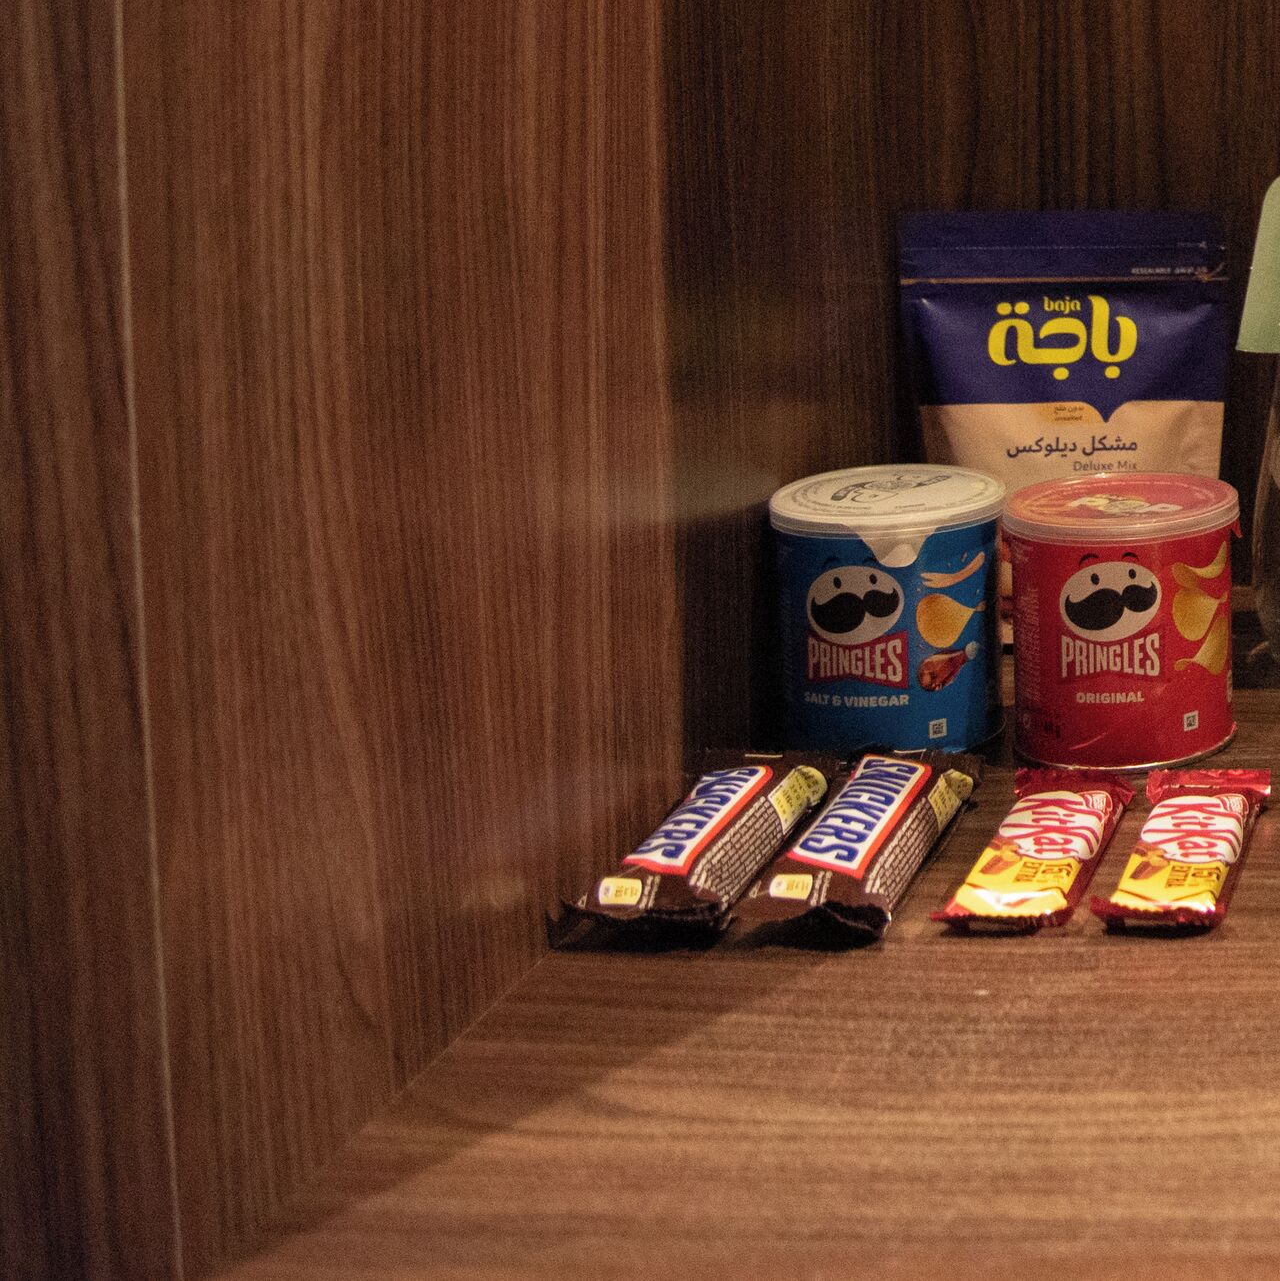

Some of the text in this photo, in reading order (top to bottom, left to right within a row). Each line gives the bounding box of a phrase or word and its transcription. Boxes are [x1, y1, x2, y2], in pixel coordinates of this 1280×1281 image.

[1043, 296, 1081, 315] baja
[988, 294, 1138, 380] باجة
[1006, 435, 1138, 459] مشكل ديلوكس
[1073, 461, 1138, 472] Deluxe Mix
[808, 636, 903, 683] PRINGLES
[1061, 632, 1161, 679] PRINGLES
[804, 691, 830, 706] SALT
[843, 693, 910, 708] VINEGAR
[1076, 690, 1145, 704] ORIGINAL
[634, 766, 761, 860] SNICKERS
[798, 758, 921, 863] SNICKERS
[1000, 797, 1104, 856] KitKat
[1142, 803, 1243, 858] KitKat
